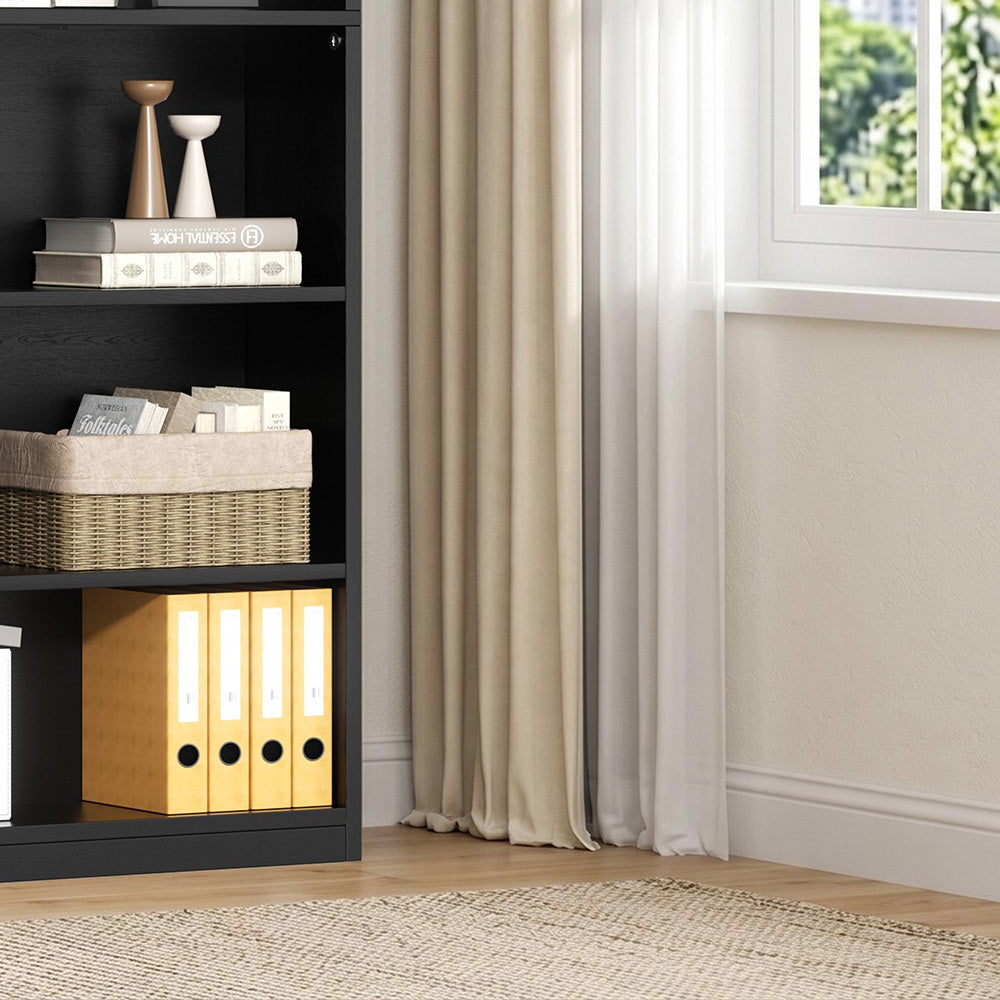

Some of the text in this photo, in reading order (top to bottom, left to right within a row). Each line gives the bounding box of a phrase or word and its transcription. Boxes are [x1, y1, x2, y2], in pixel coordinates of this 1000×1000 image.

[151, 232, 236, 245] ESSENTIAL HOME
[76, 414, 134, 435] Folktales
